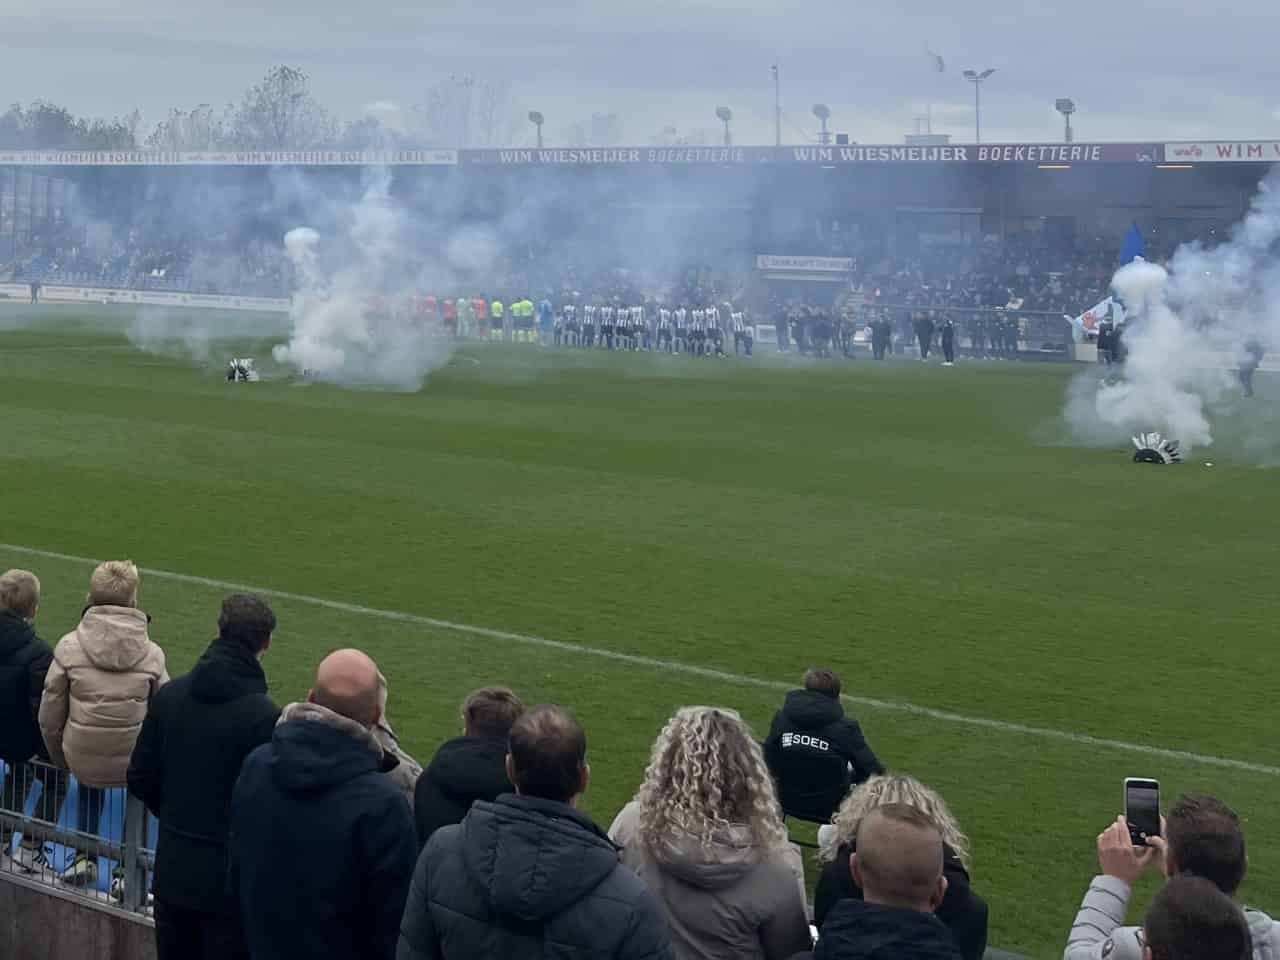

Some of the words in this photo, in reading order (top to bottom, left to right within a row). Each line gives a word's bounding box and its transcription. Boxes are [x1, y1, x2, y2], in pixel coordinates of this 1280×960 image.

[500, 150, 533, 163] WIM
[538, 150, 640, 163] WIESMEIJER
[647, 150, 744, 162] BOEKETTERIE
[793, 147, 833, 161] WIM
[840, 146, 969, 161] WIESMEIJER
[978, 145, 1102, 161] BOEKETTERIE
[1217, 144, 1264, 158] WIM
